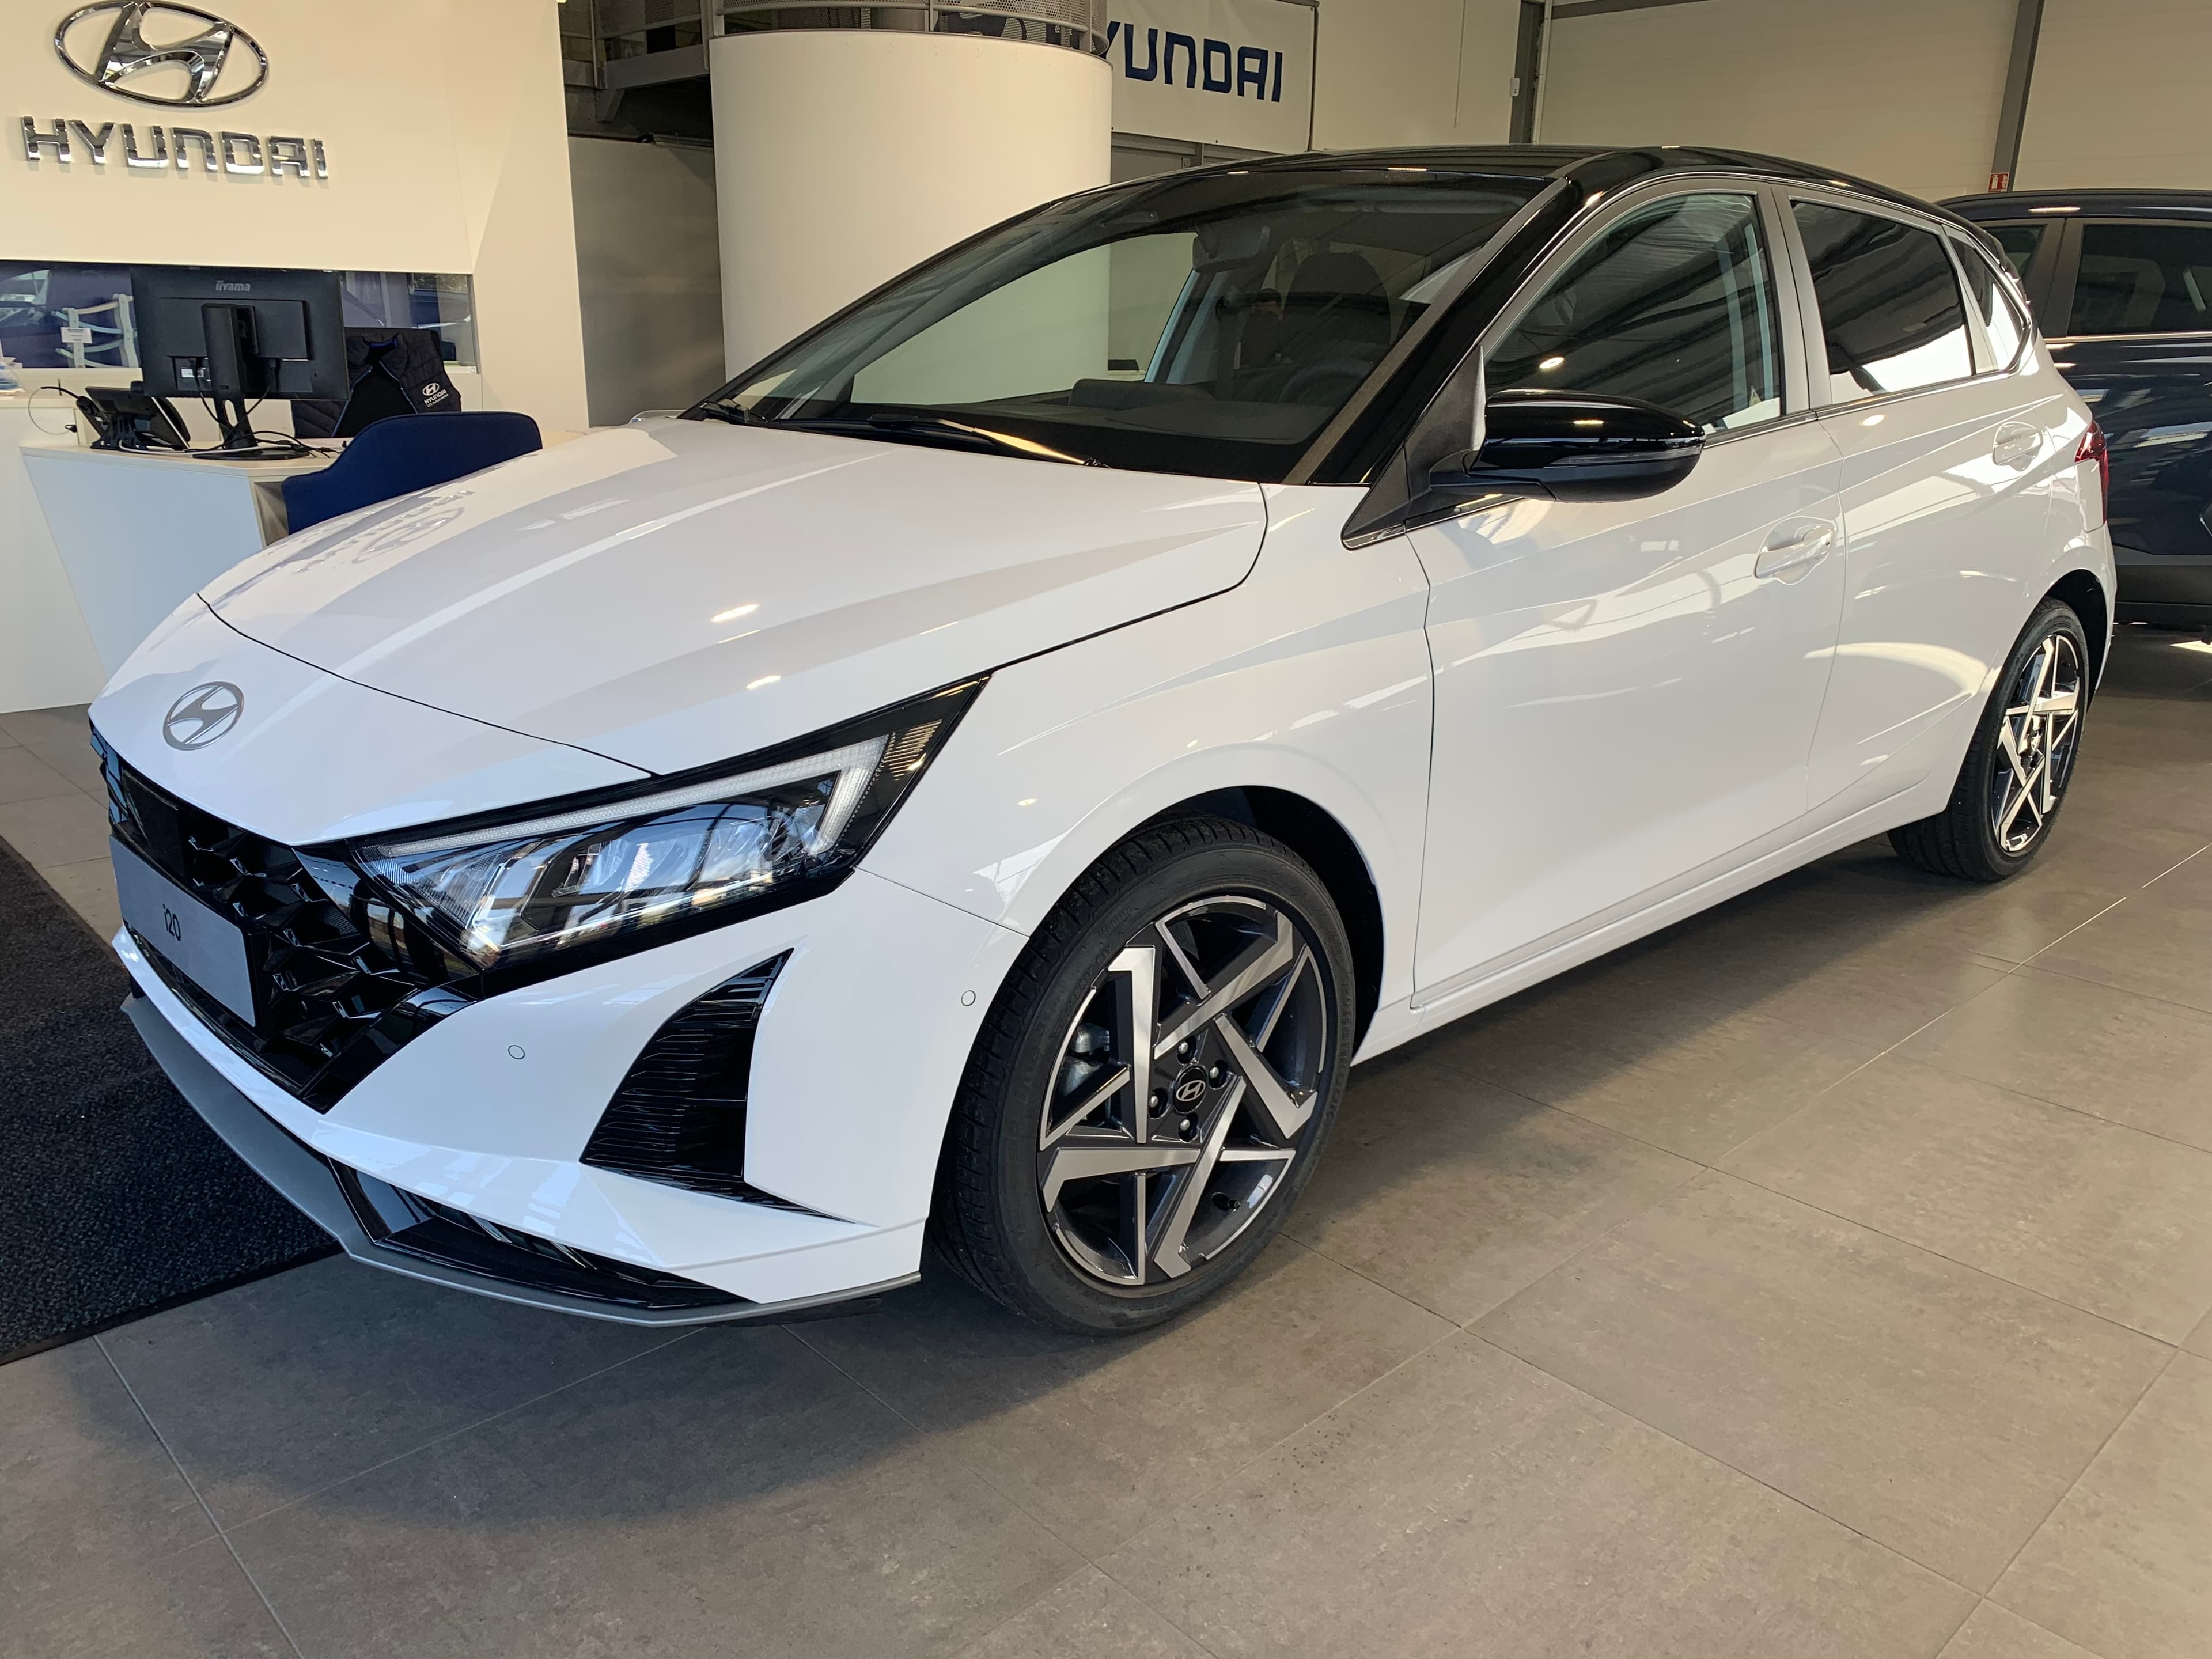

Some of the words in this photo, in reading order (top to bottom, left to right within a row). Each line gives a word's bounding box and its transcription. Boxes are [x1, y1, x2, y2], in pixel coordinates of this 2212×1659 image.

[1099, 21, 1283, 102] UNDAI
[21, 116, 328, 179] HYUNDAI
[215, 279, 251, 291] iiyama
[424, 389, 447, 404] HYUNDAI
[162, 903, 181, 941] i20
